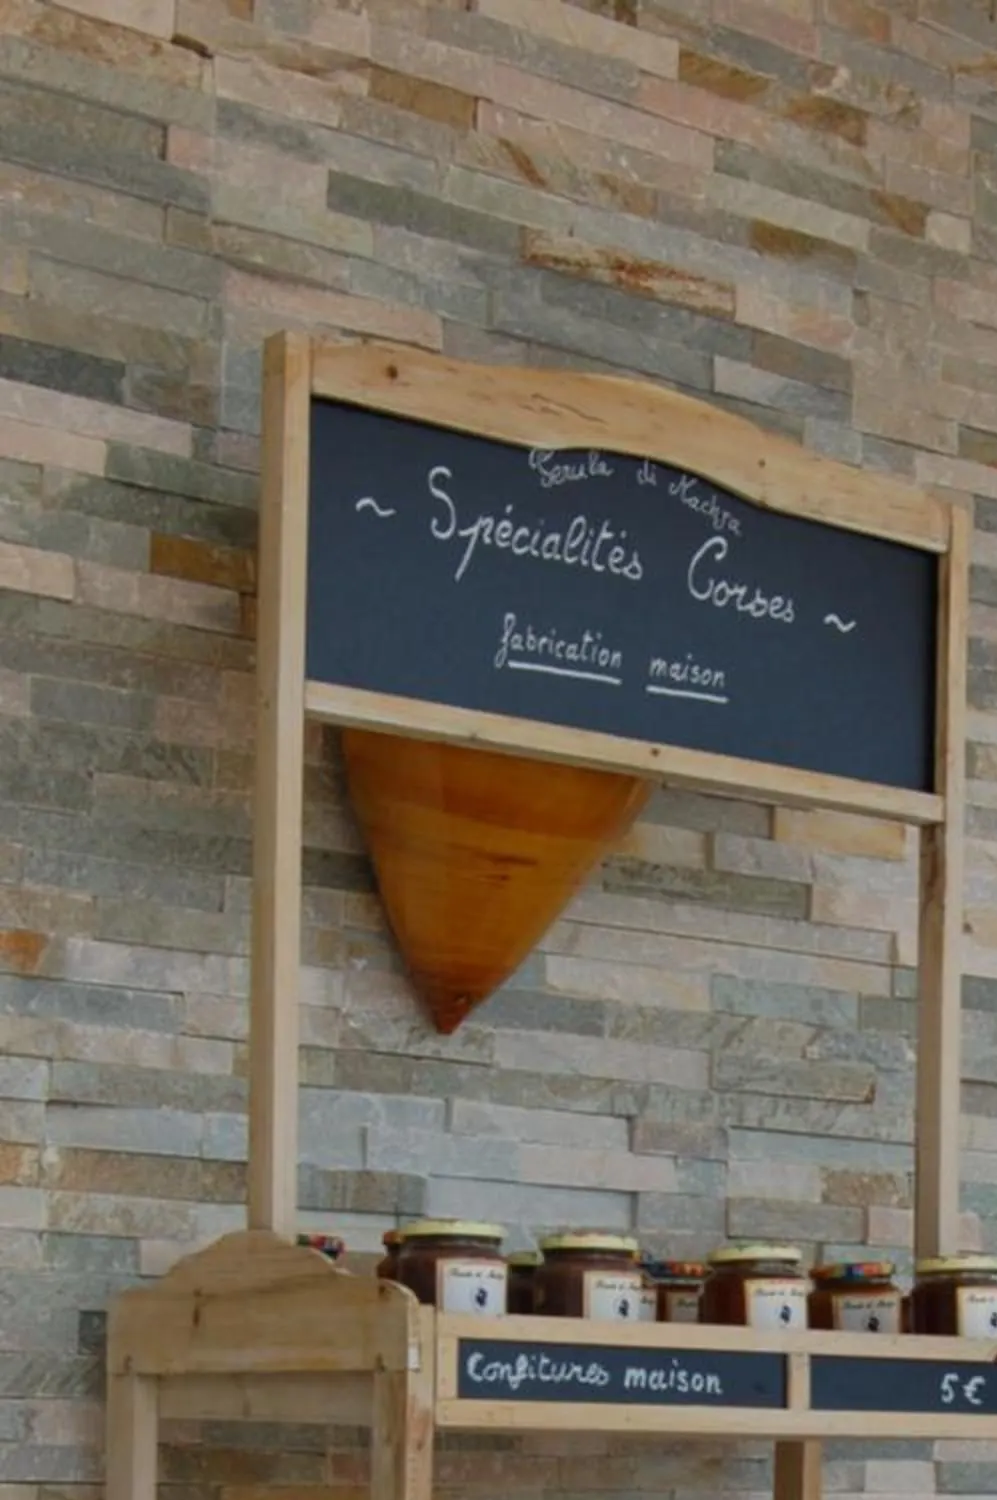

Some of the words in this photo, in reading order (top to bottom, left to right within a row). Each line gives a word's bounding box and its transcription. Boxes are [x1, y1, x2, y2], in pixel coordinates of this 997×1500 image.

[427, 465, 644, 582] Spécialités
[687, 535, 795, 624] Corses
[494, 612, 623, 670] fabrication
[649, 653, 726, 688] maison
[466, 1352, 609, 1390] Confitures
[623, 1358, 723, 1395] maison
